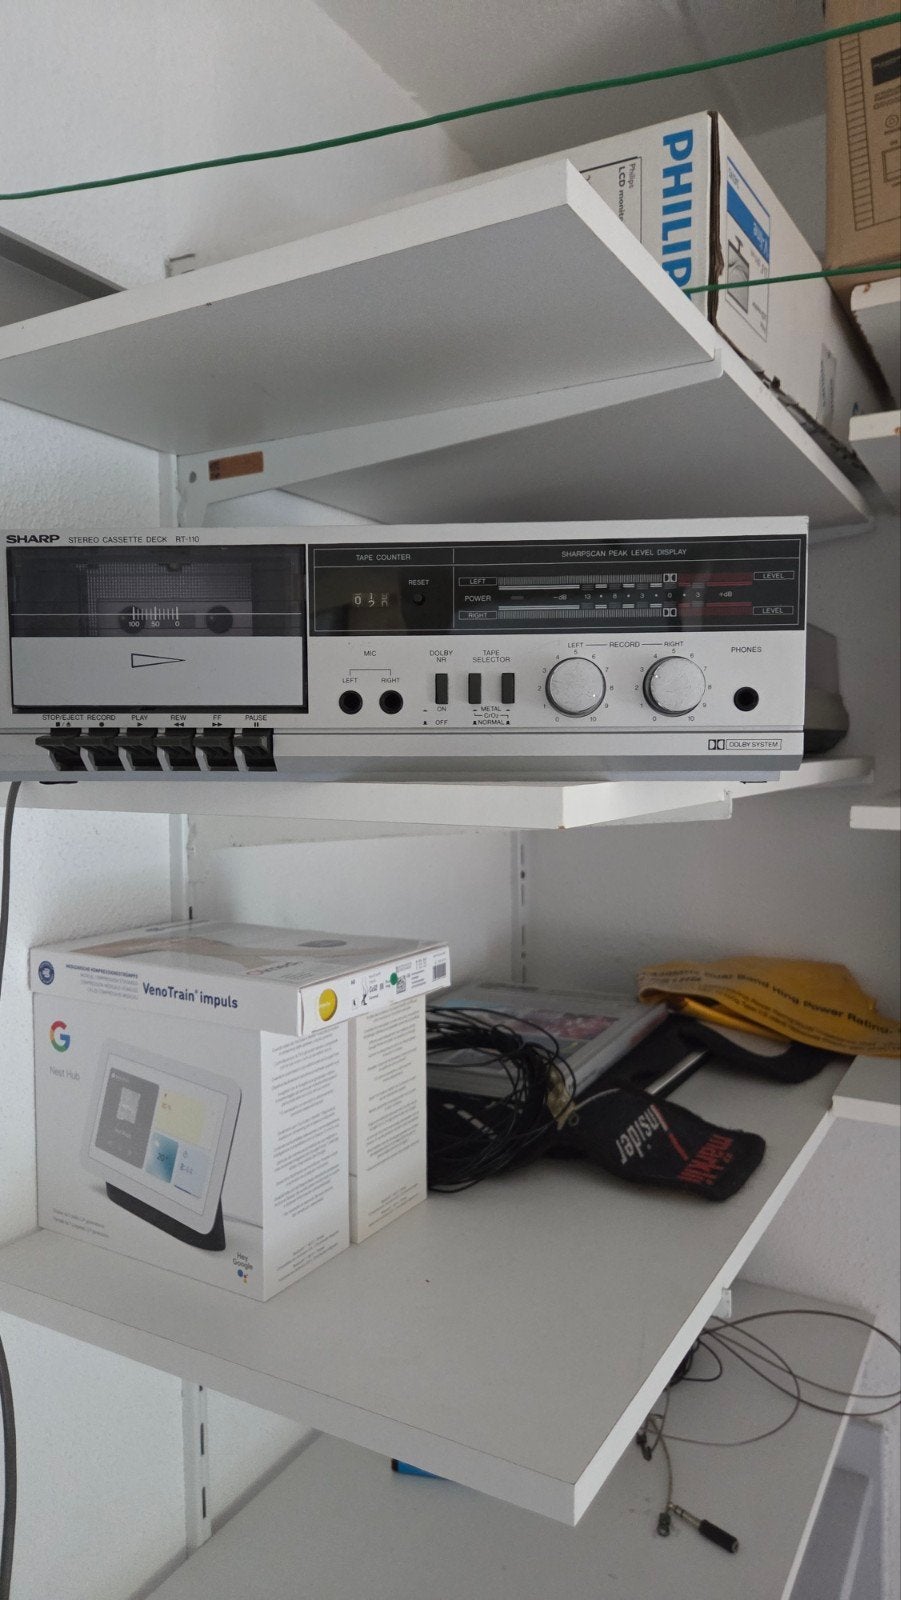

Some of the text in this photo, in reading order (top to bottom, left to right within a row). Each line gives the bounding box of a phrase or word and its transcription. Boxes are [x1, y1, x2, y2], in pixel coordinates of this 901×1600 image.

[628, 163, 636, 189] Philips
[662, 129, 694, 301] PHILIP
[6, 534, 60, 544] SHARP
[102, 536, 143, 544] CASSETTE
[200, 992, 238, 1010] impuls
[50, 1020, 70, 1052] G
[50, 1066, 80, 1081] Nest Hub
[616, 1104, 668, 1165] Insider
[232, 1258, 254, 1271] Google
[236, 1250, 248, 1262] Hey
